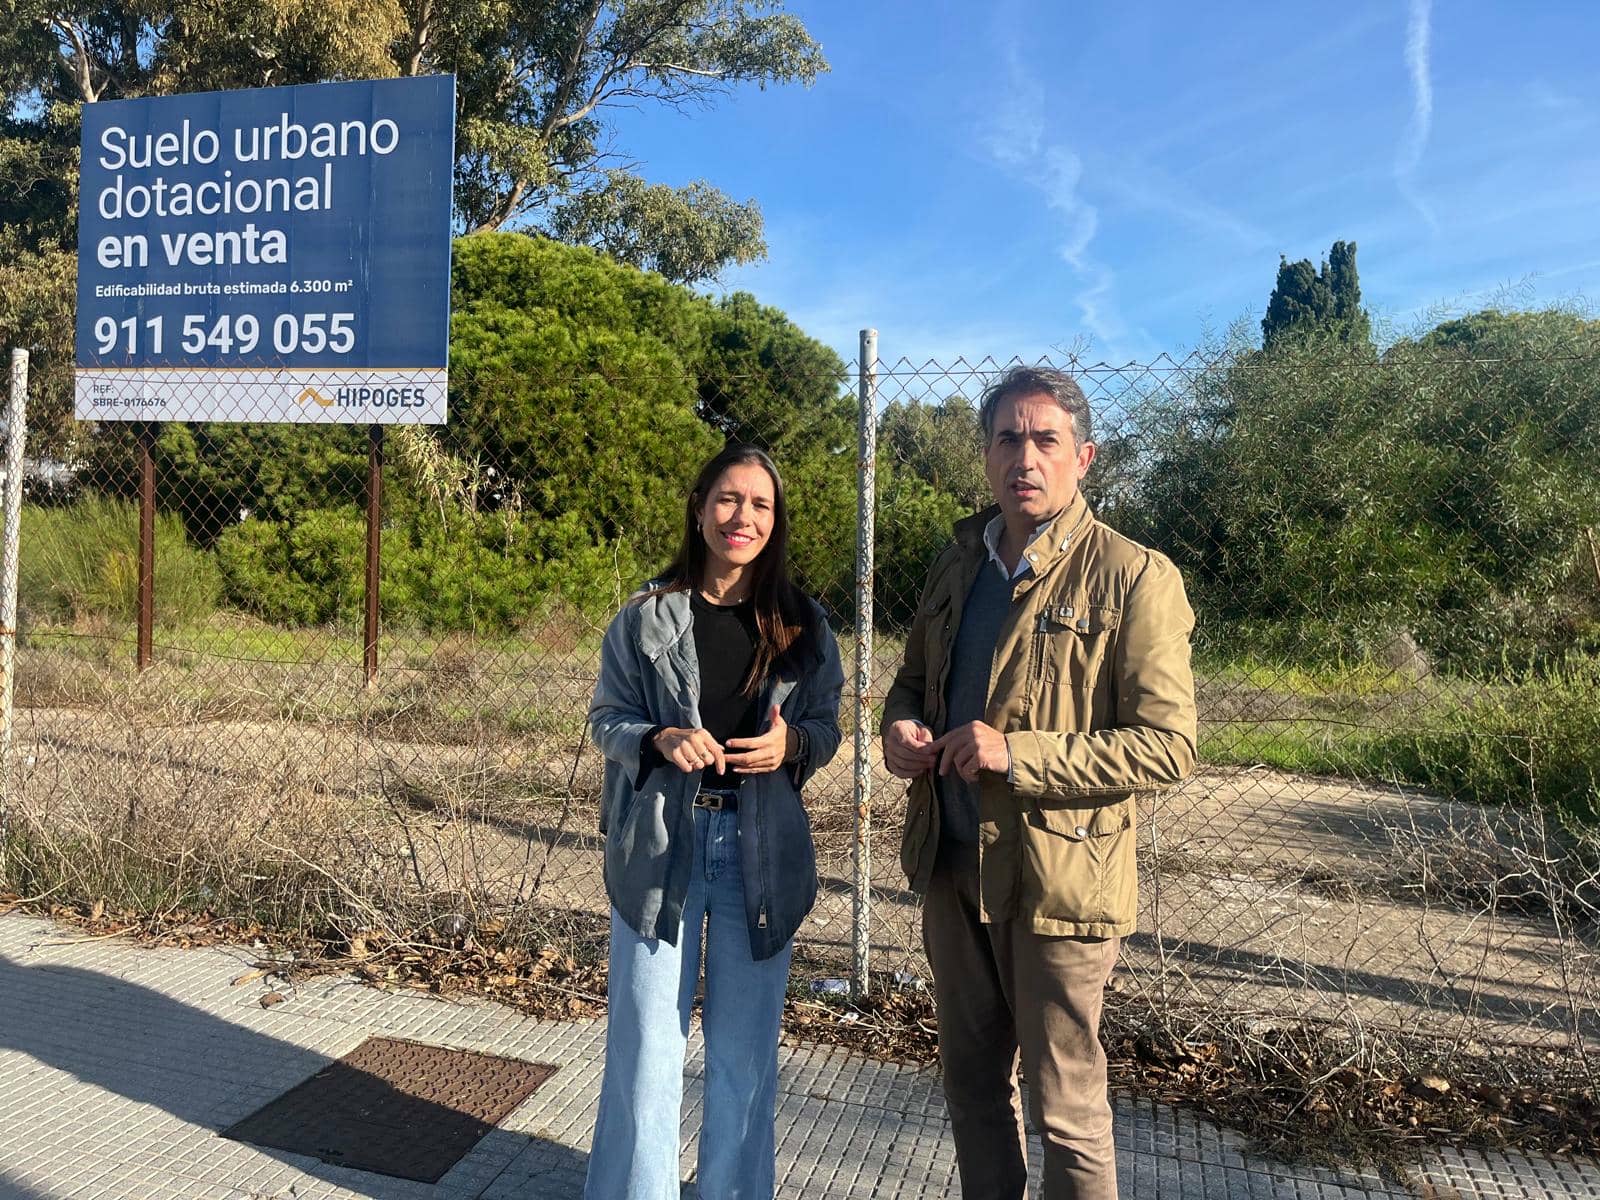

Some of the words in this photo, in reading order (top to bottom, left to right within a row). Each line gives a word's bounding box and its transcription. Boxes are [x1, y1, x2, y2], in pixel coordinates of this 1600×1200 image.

[99, 119, 220, 170] Suelo
[234, 112, 399, 162] urbano
[98, 163, 332, 220] dotacional
[97, 234, 148, 268] en
[161, 223, 287, 266] venta
[95, 283, 181, 297] Edificabilidad
[184, 282, 221, 295] bruta
[223, 281, 287, 294] estimada
[290, 280, 331, 293] 6.300
[94, 315, 163, 355] 911
[181, 314, 260, 354] 549
[273, 313, 355, 354] 055
[337, 388, 425, 407] HIPOGES
